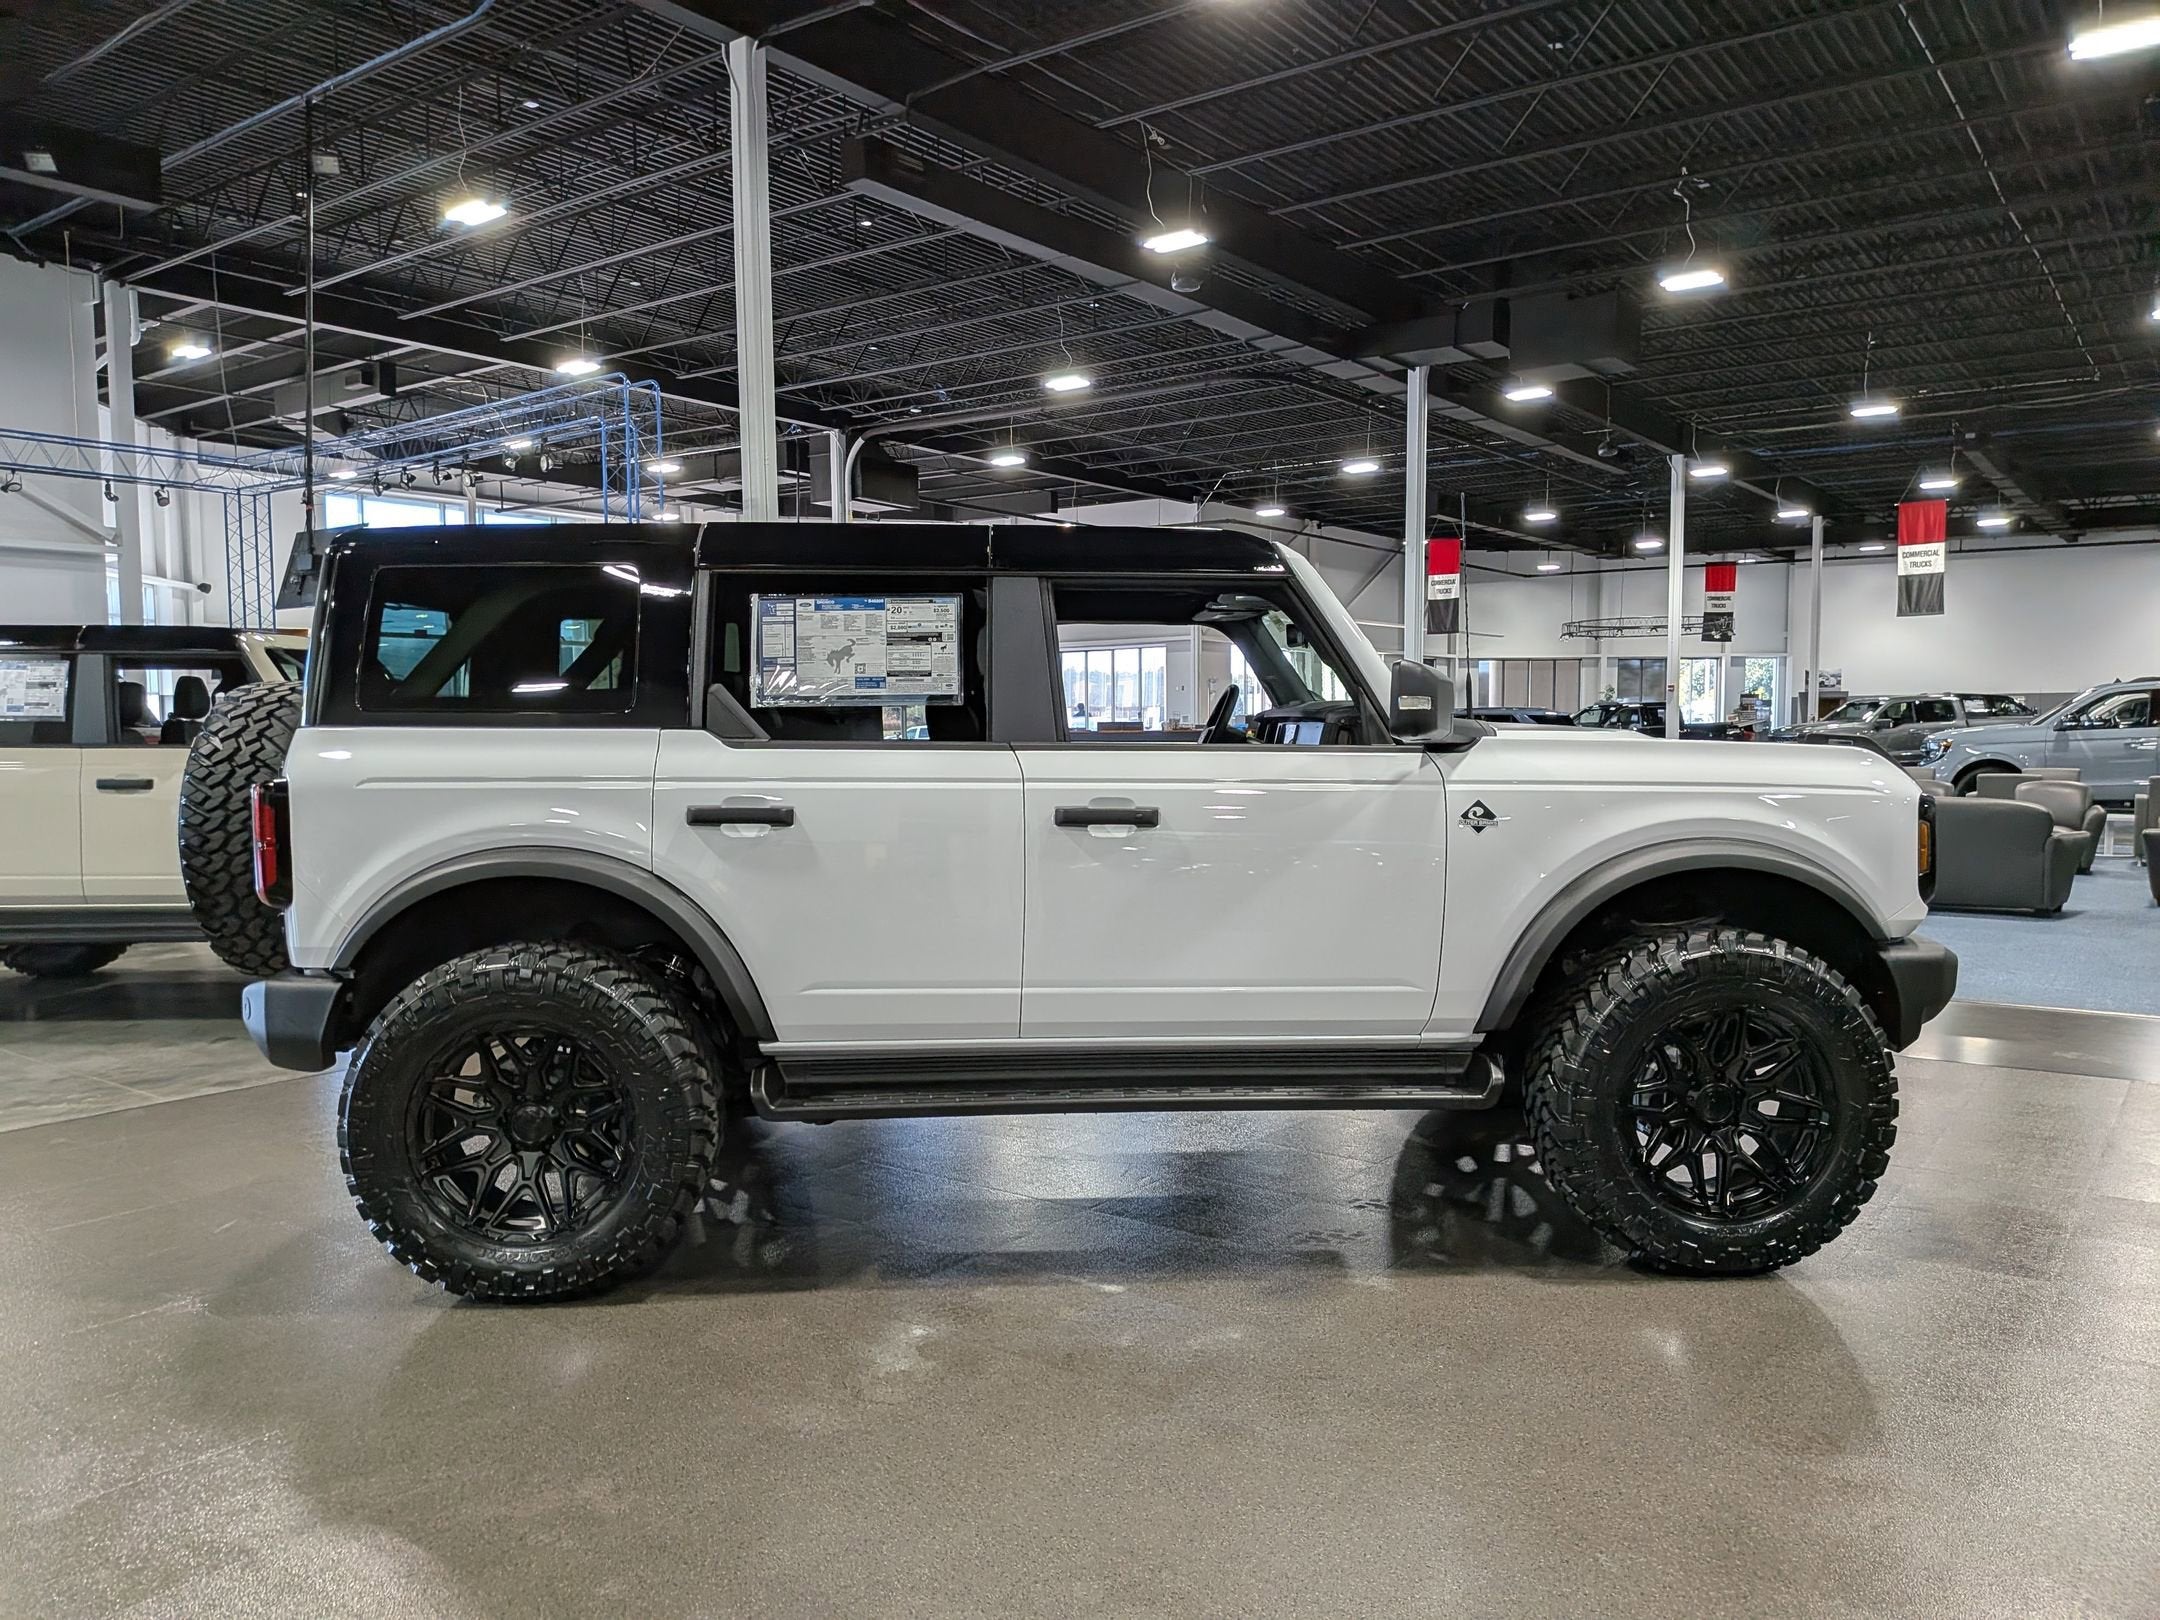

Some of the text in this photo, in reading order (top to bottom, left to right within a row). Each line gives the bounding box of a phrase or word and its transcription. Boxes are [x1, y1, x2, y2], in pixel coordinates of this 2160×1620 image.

[1902, 549, 1940, 559] COMMERCIAL
[1909, 560, 1932, 568] TRUCKS
[890, 606, 903, 614] 20
